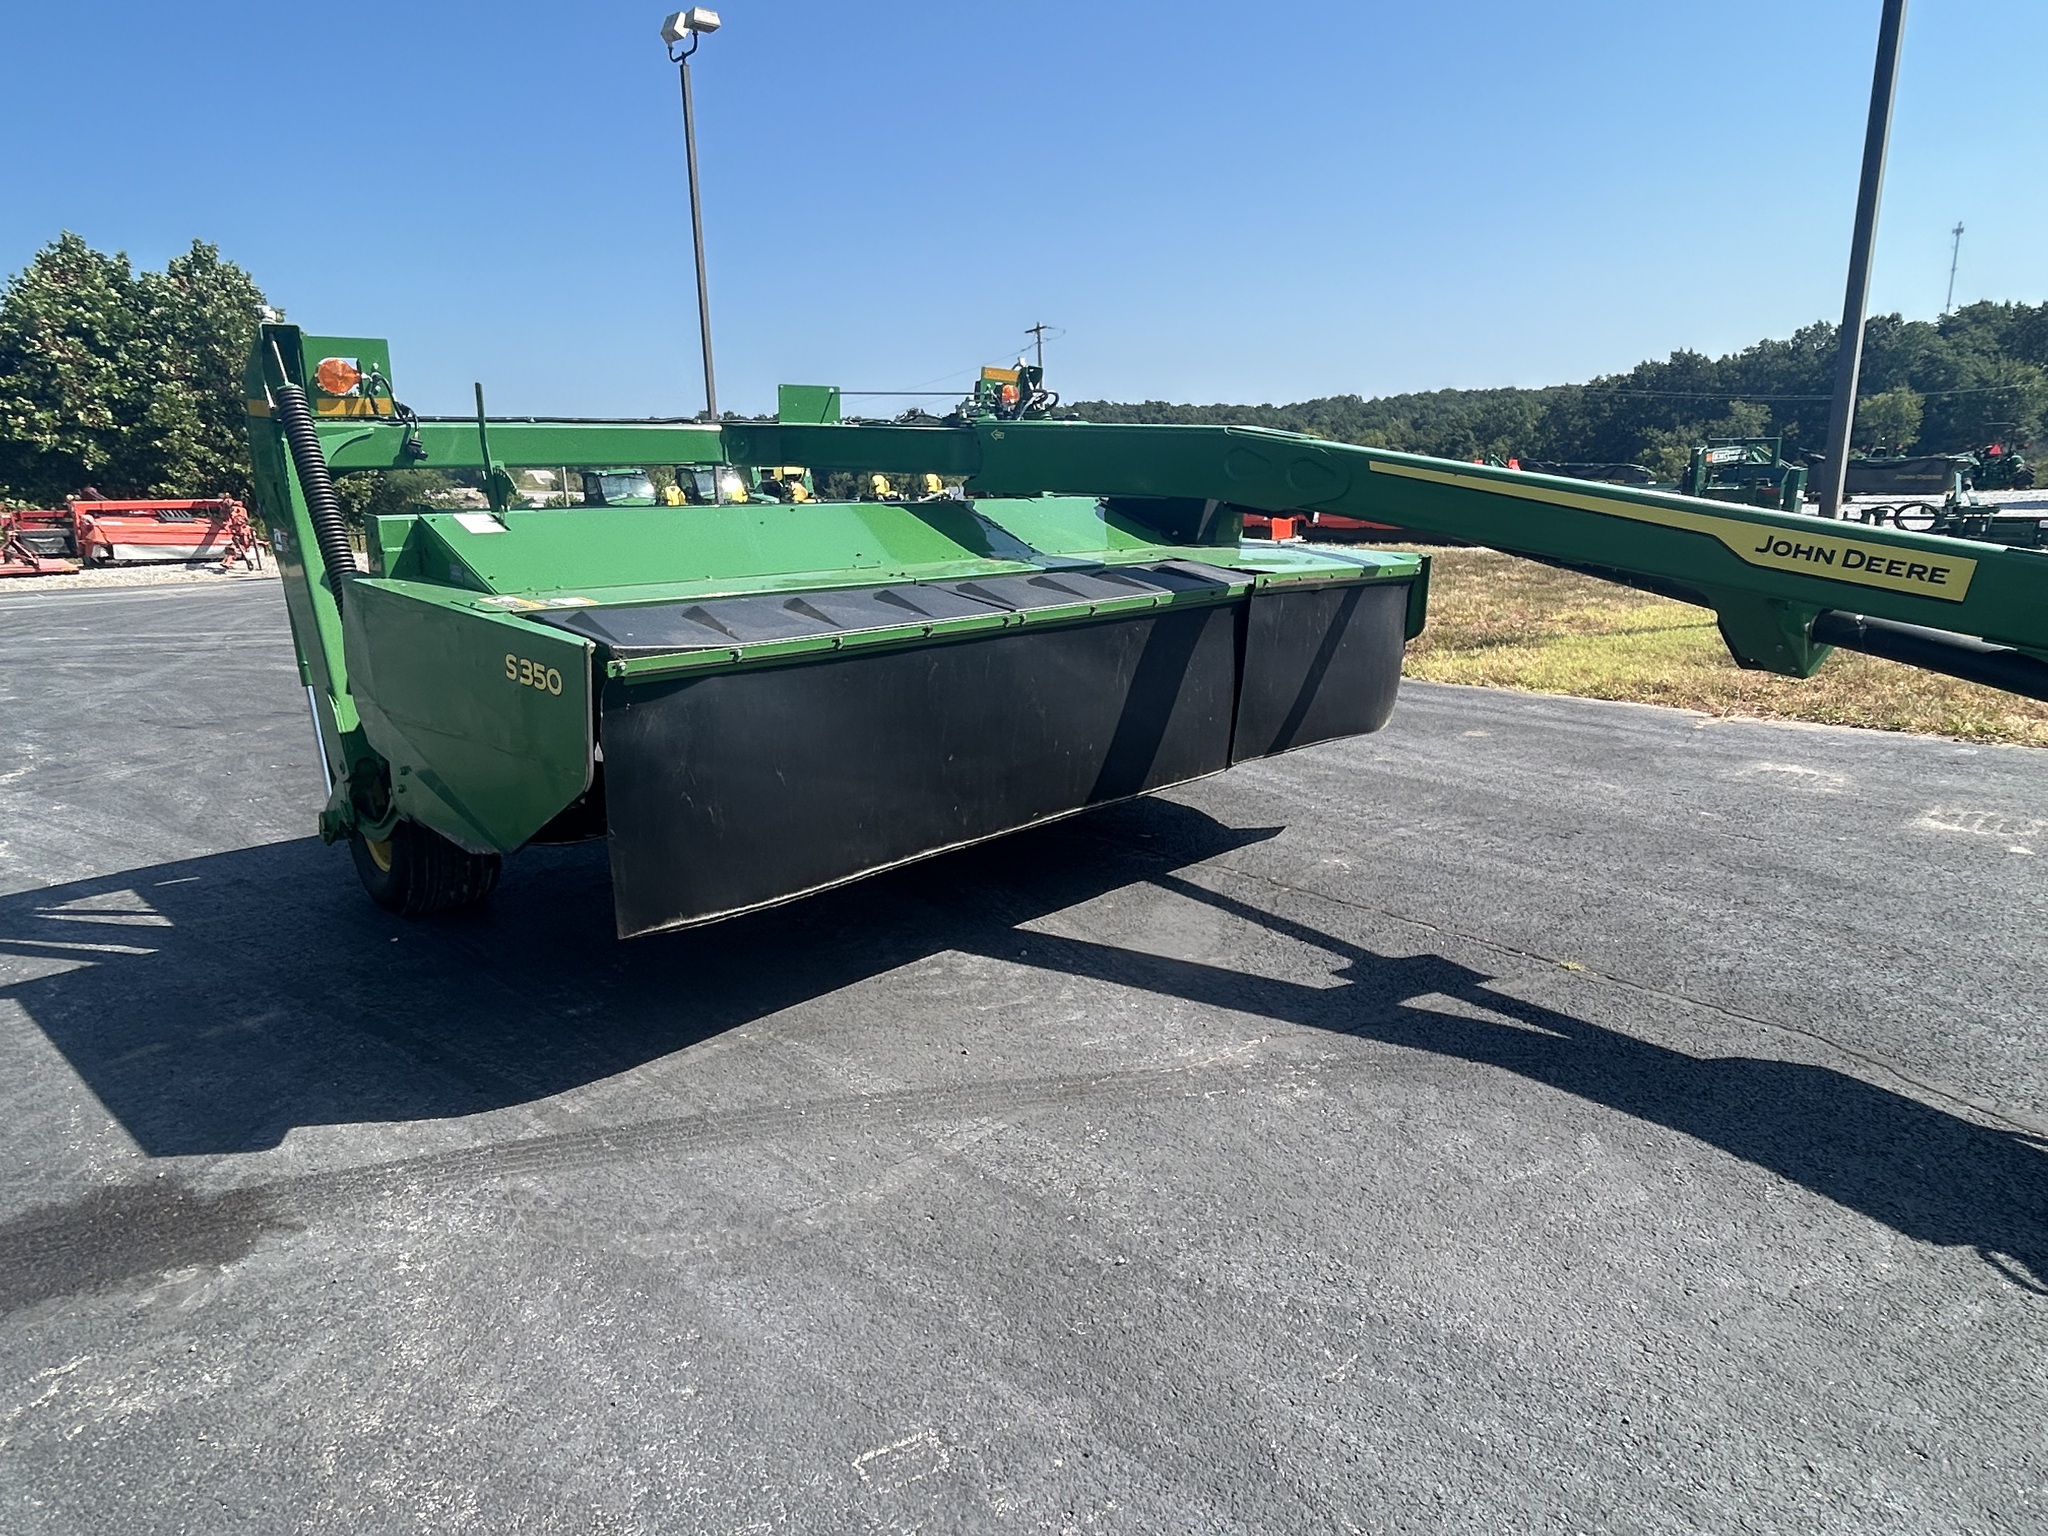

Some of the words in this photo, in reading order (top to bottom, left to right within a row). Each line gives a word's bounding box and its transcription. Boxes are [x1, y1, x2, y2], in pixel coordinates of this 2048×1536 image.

[1755, 535, 1836, 565] JOHN
[1841, 549, 1950, 585] DEERE
[505, 653, 563, 696] S350
